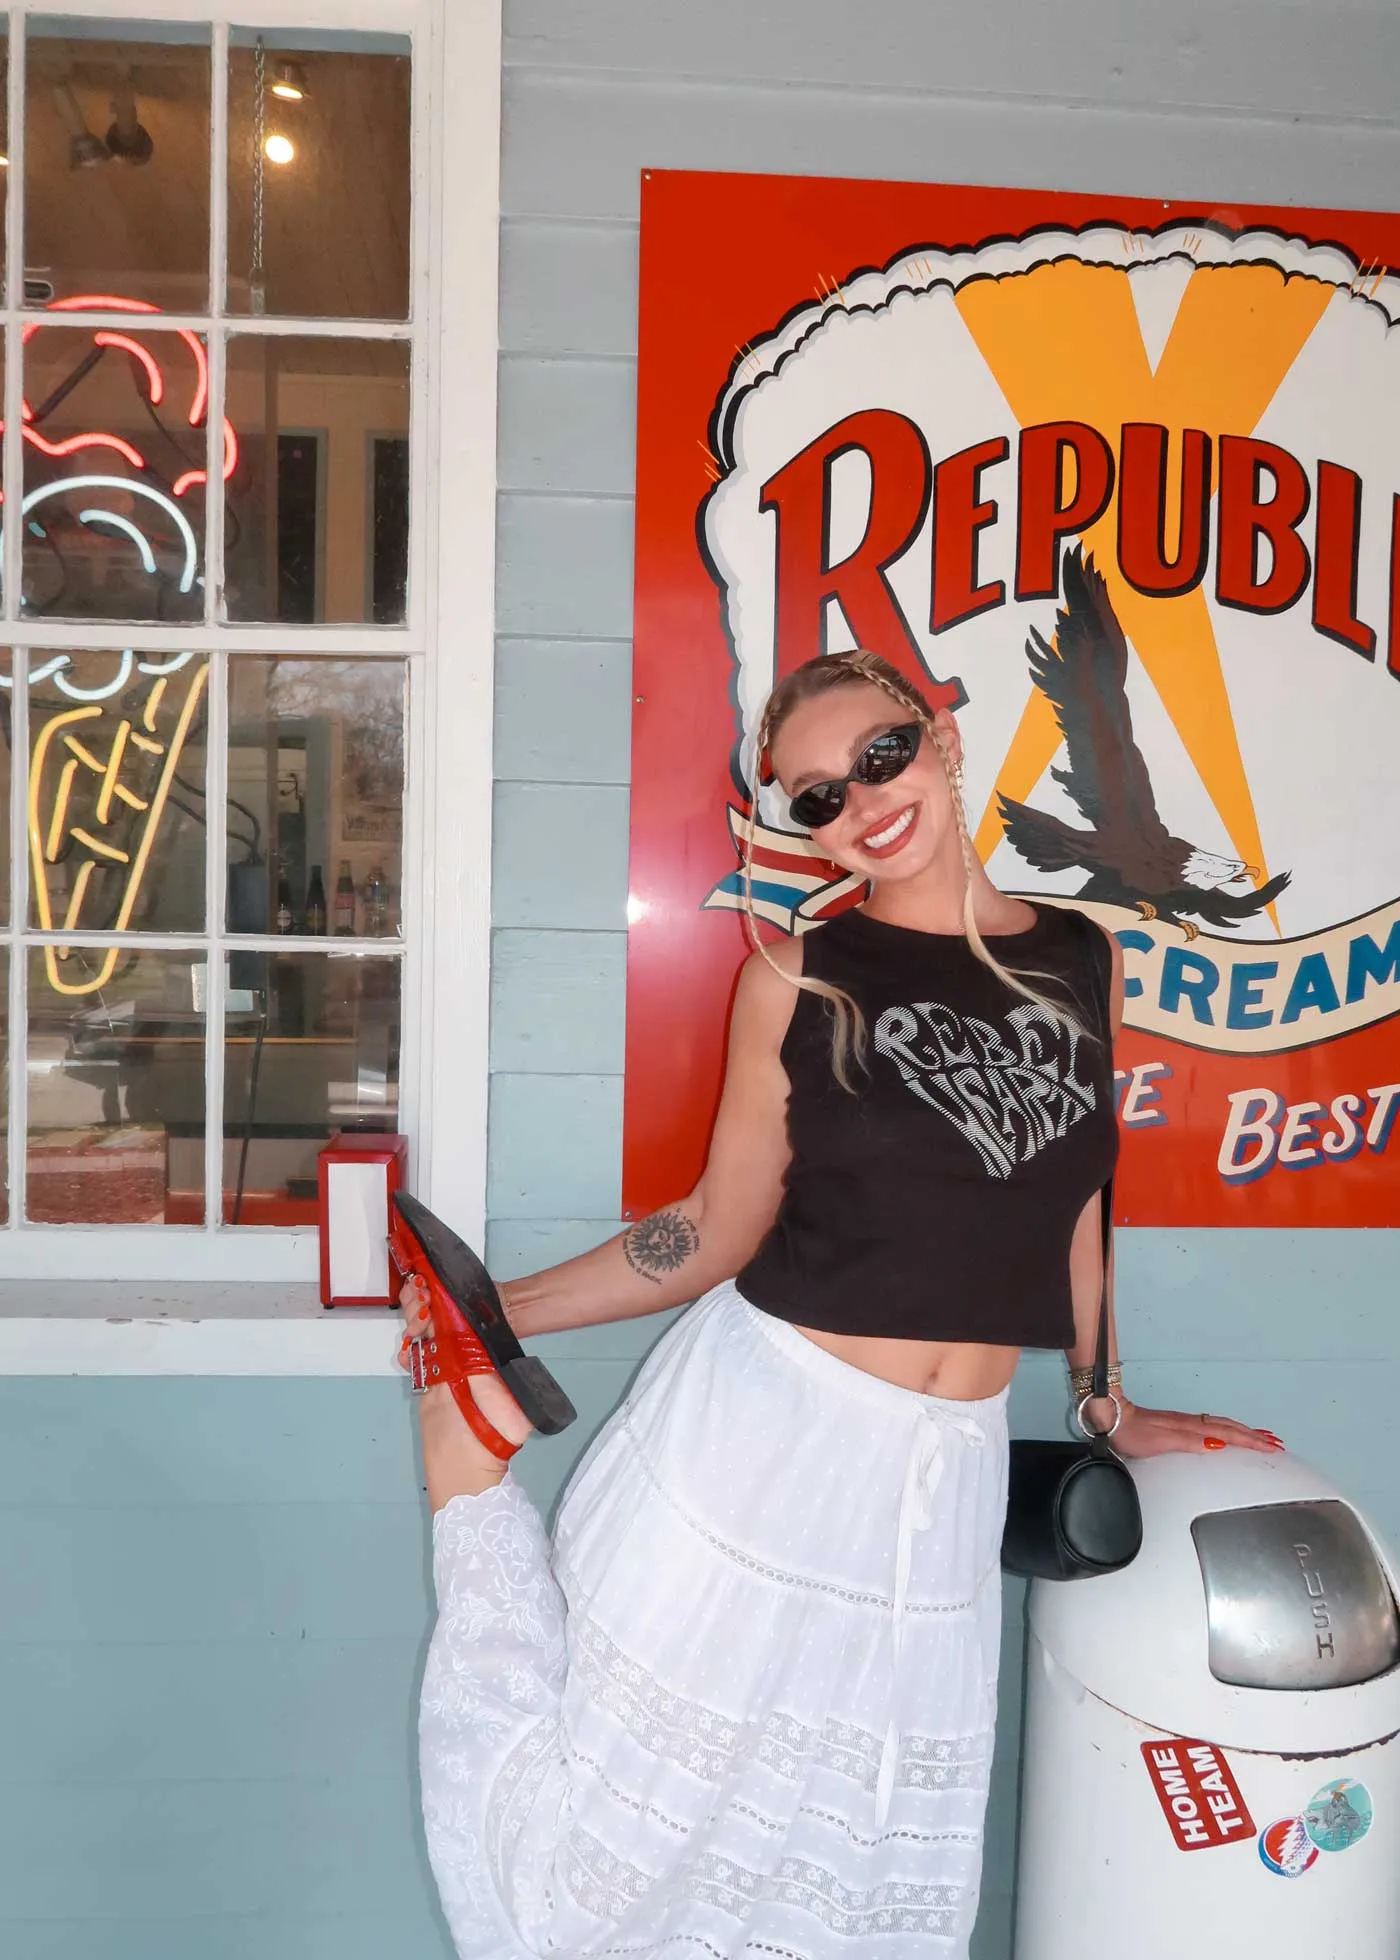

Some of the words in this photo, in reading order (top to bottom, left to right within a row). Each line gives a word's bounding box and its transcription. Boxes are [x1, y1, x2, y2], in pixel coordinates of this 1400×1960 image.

[874, 1001, 1096, 1112] REBEL
[1216, 1083, 1400, 1185] BEST
[1293, 1543, 1335, 1660] PUSH
[1151, 1747, 1210, 1844] HOME
[1186, 1745, 1244, 1836] TEAM
